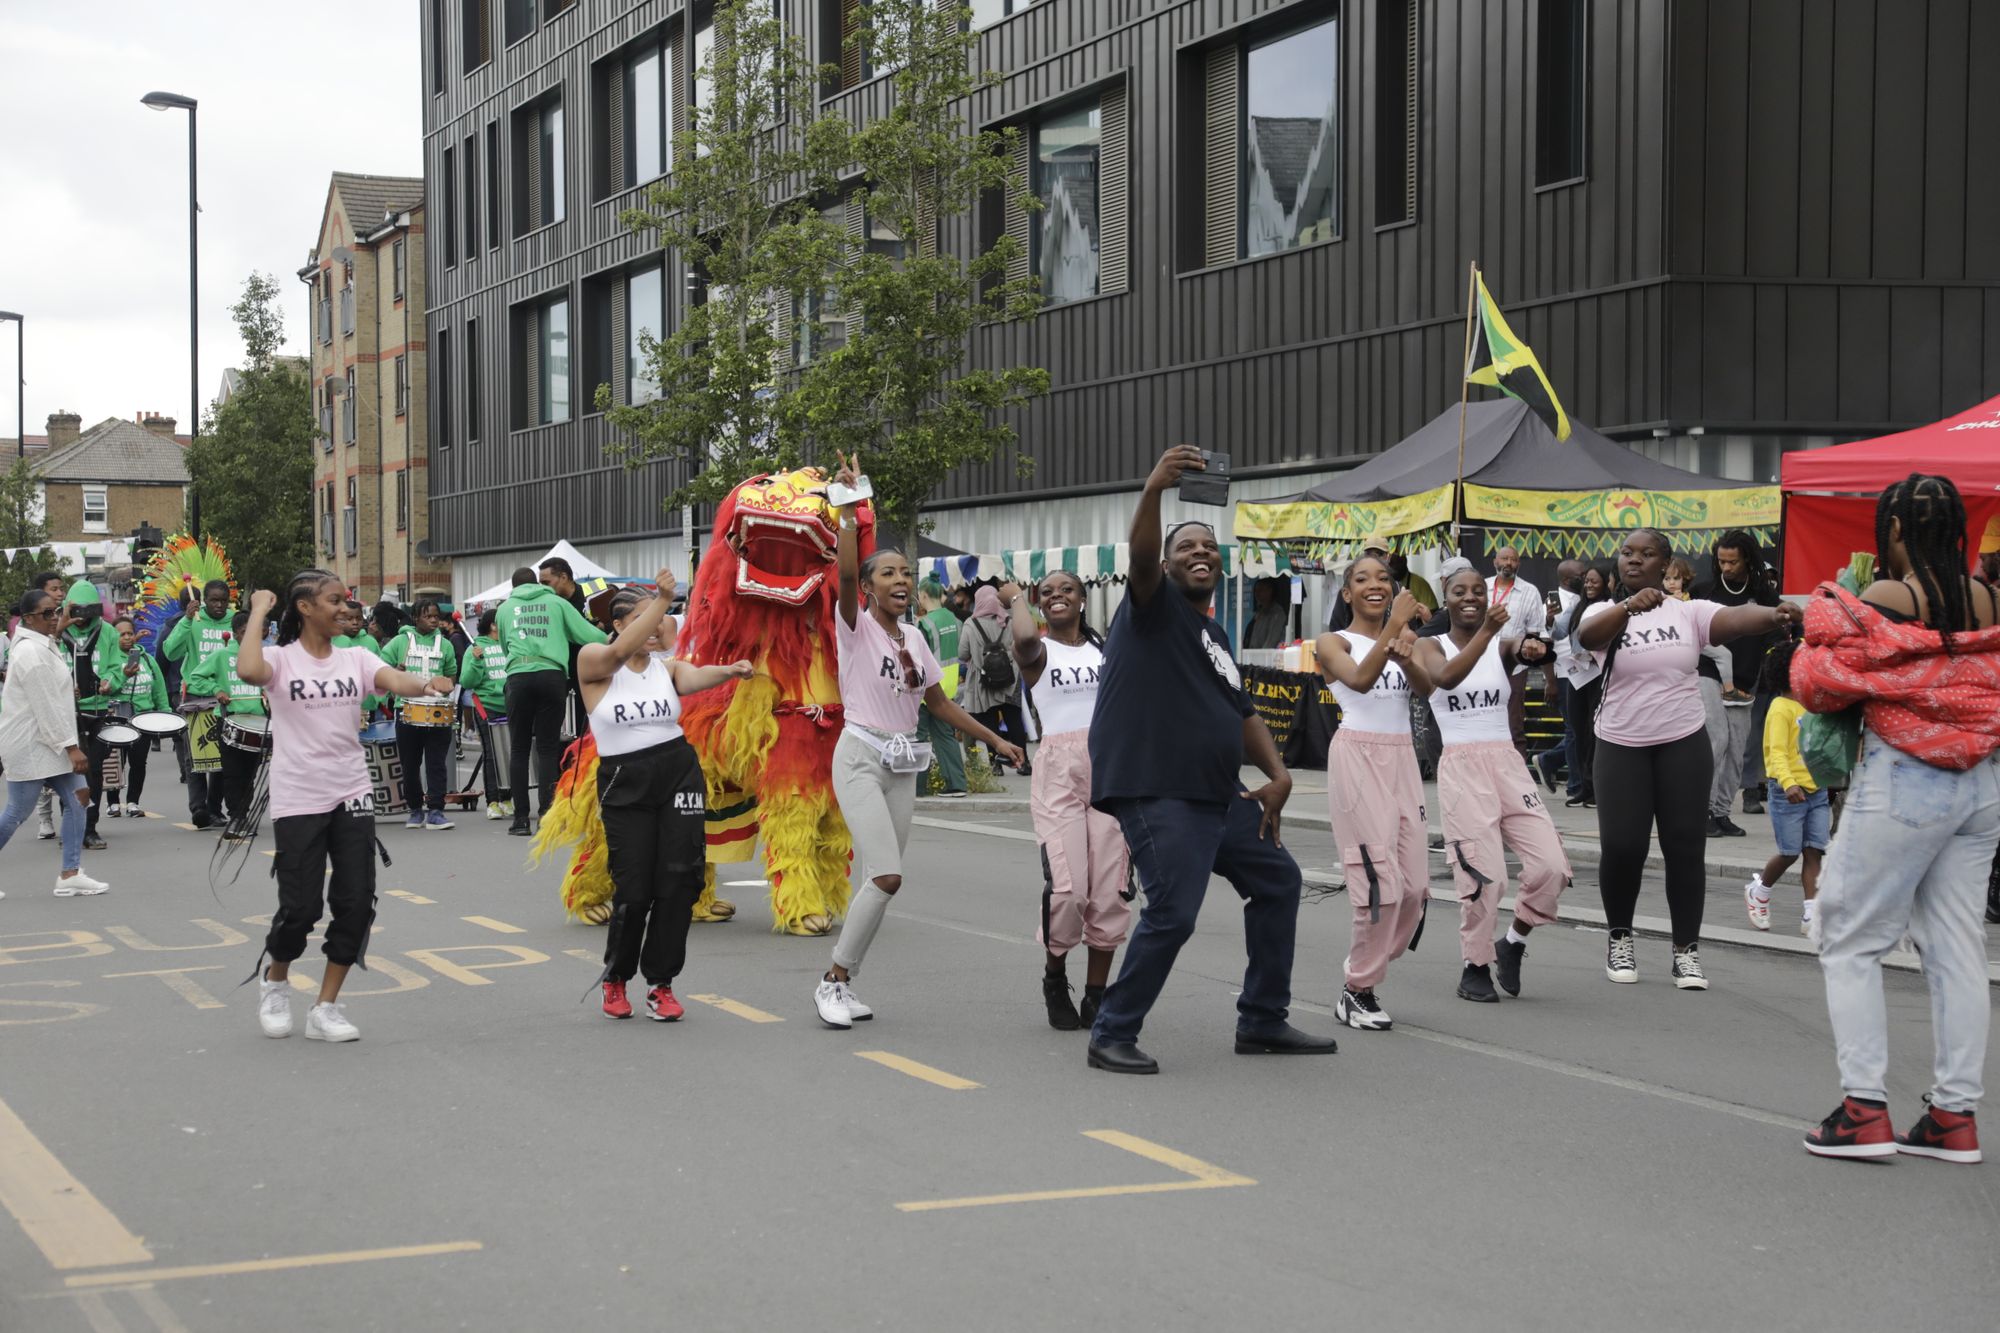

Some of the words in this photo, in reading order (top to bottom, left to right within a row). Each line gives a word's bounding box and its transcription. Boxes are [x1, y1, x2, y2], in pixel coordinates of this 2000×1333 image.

[514, 603, 547, 616] SOUTH
[513, 615, 550, 628] LONDON
[202, 628, 234, 640] SOU
[519, 627, 548, 640] SAMBA
[1617, 625, 1681, 650] R.Y.M
[485, 656, 507, 667] LOND
[489, 670, 508, 680] SAM
[1370, 671, 1410, 691] .Y.M
[230, 684, 260, 696] SAMBA
[289, 676, 359, 702] R.Y.M
[1447, 688, 1500, 712] R.Y.M
[613, 699, 672, 724] R.Y.M
[674, 792, 704, 809] R.Y.M
